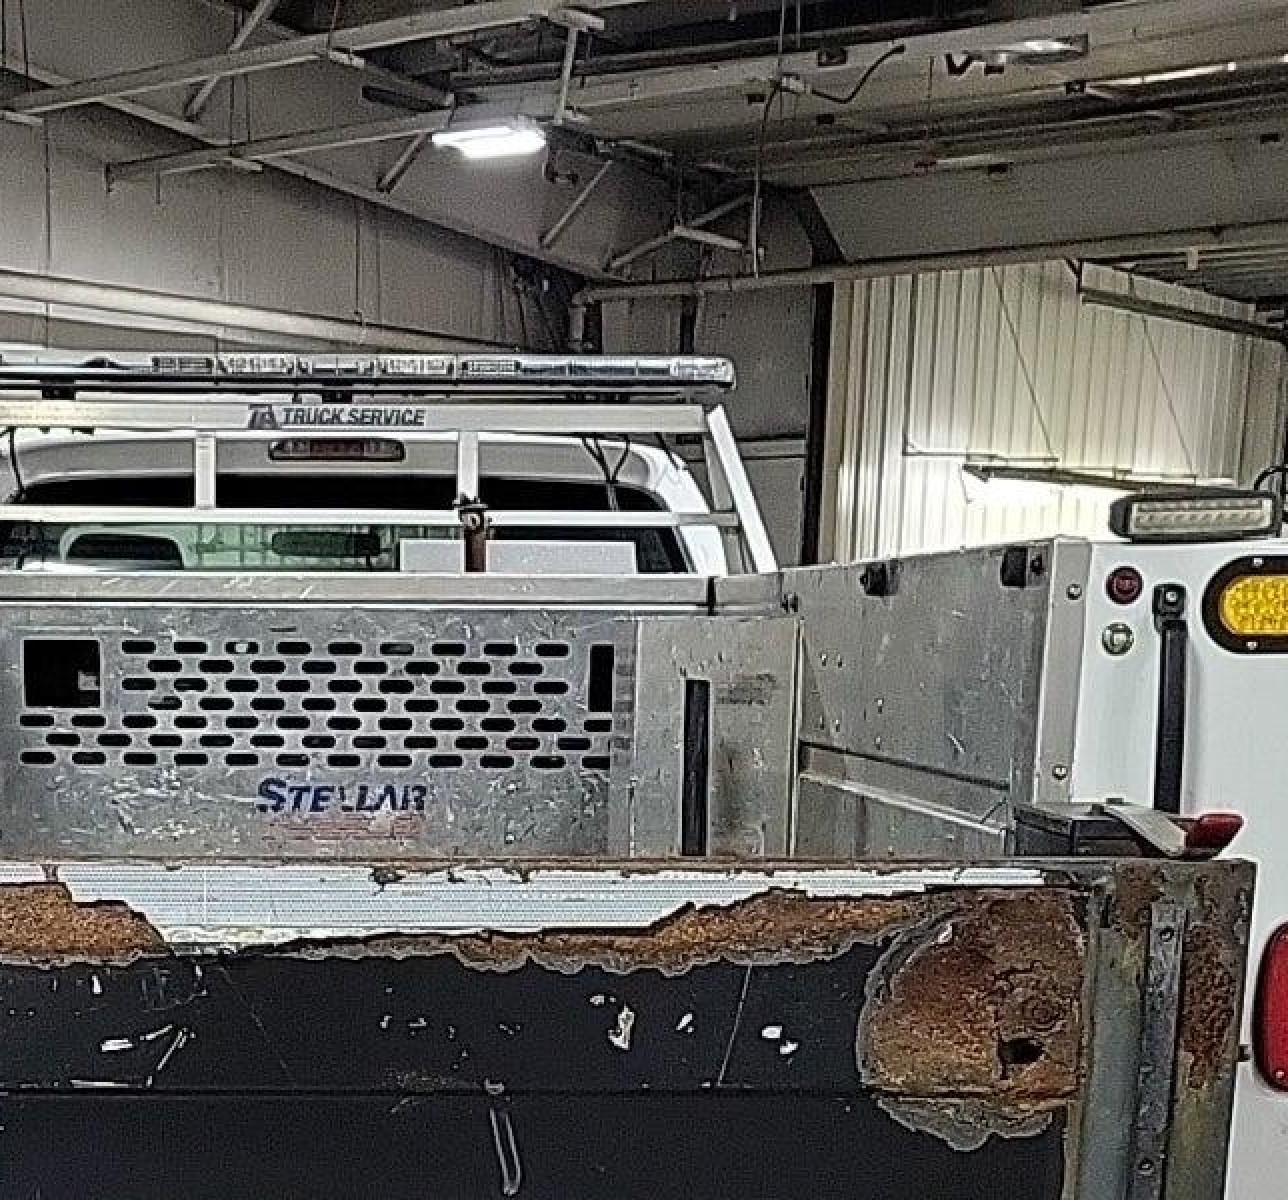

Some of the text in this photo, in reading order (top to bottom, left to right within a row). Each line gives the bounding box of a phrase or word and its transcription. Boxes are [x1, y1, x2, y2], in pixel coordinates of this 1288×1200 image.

[283, 407, 344, 426] TRUCK
[347, 408, 426, 427] SERVICE
[256, 777, 427, 813] STELLAR
